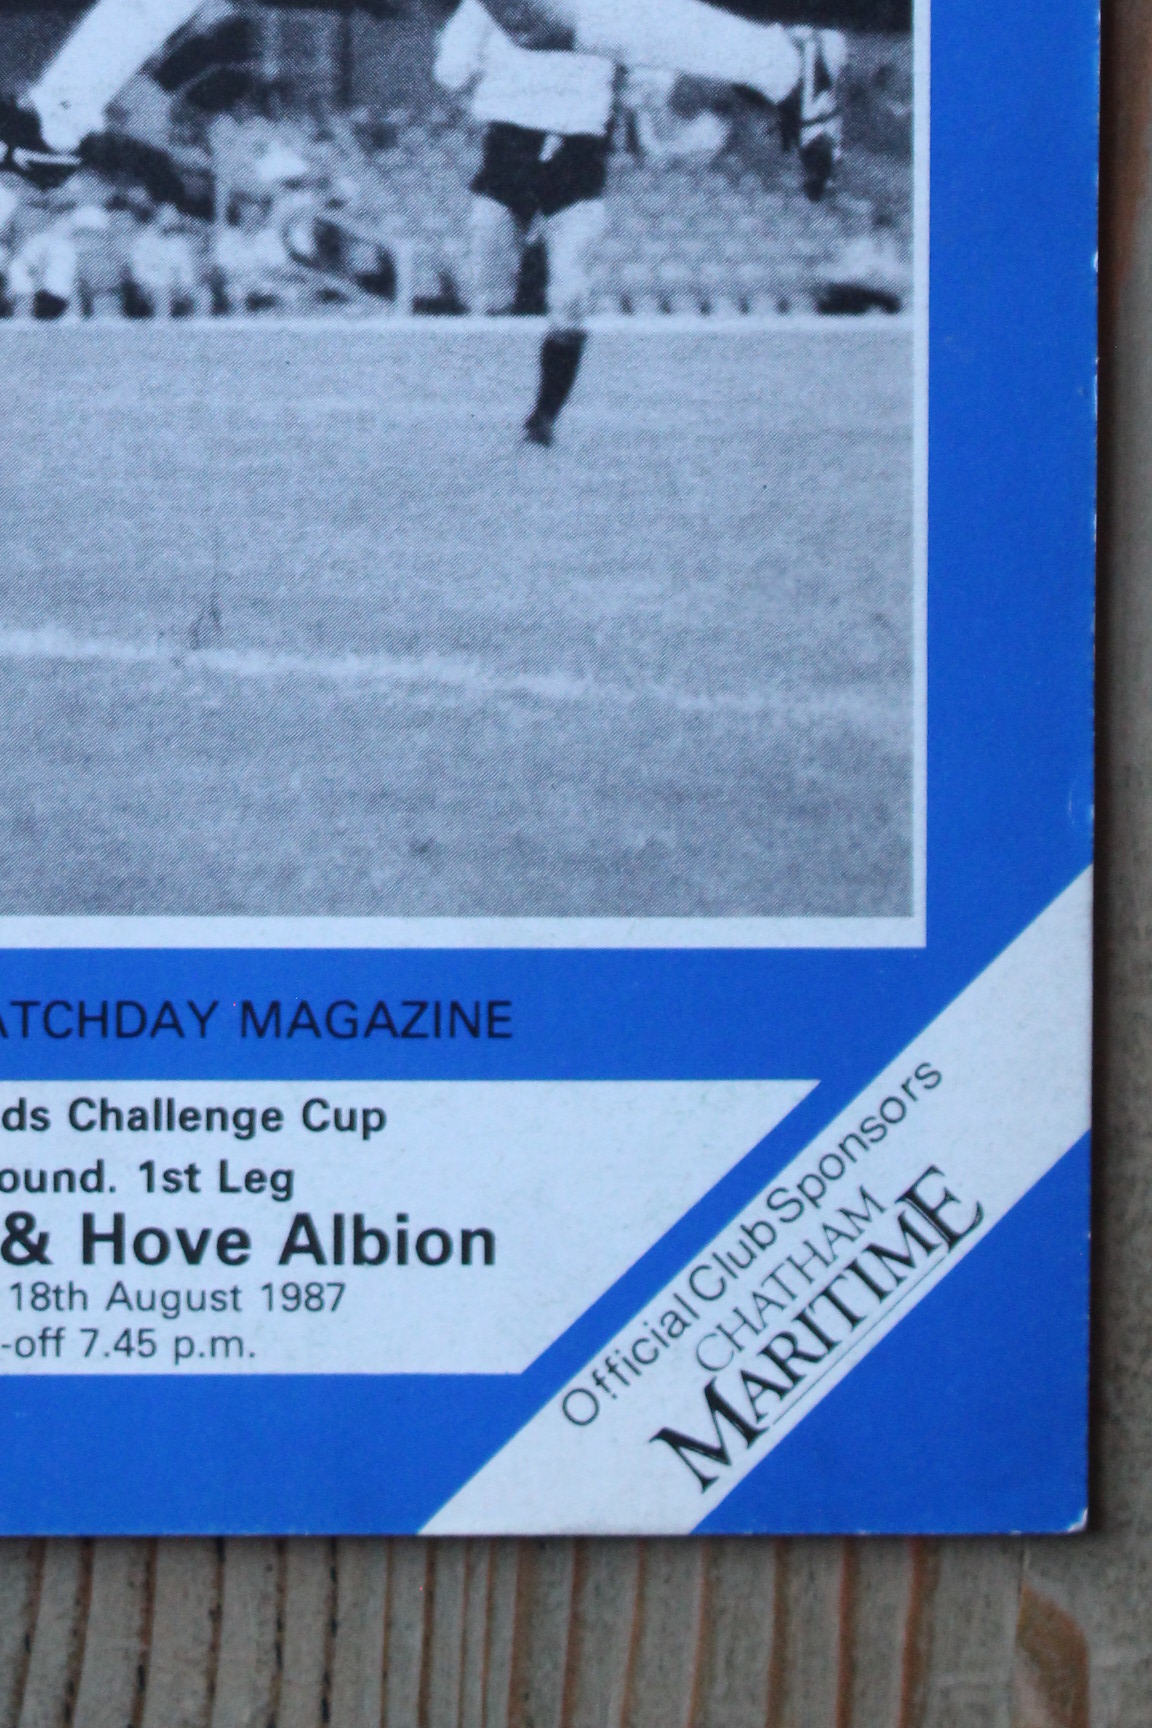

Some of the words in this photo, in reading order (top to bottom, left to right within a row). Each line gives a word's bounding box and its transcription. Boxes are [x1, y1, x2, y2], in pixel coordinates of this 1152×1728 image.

[242, 1001, 511, 1038] MAGAZINE
[68, 1097, 284, 1141] Challenge
[302, 1098, 386, 1141] Cup
[139, 1160, 201, 1194] 1st
[219, 1159, 294, 1202] Leg
[0, 1211, 53, 1267] &
[82, 1212, 251, 1266] Hove
[278, 1212, 495, 1267] Albion
[560, 1290, 701, 1428] Official
[687, 1214, 780, 1303] Club
[766, 1060, 943, 1224] Sponsors
[10, 1281, 87, 1311] 18th
[106, 1281, 241, 1320] August
[262, 1282, 345, 1312] 1987
[694, 1186, 887, 1374] CHATHAM
[80, 1328, 157, 1358] 7.45
[175, 1336, 255, 1365] p.m.
[648, 1165, 985, 1494] MARITIME
